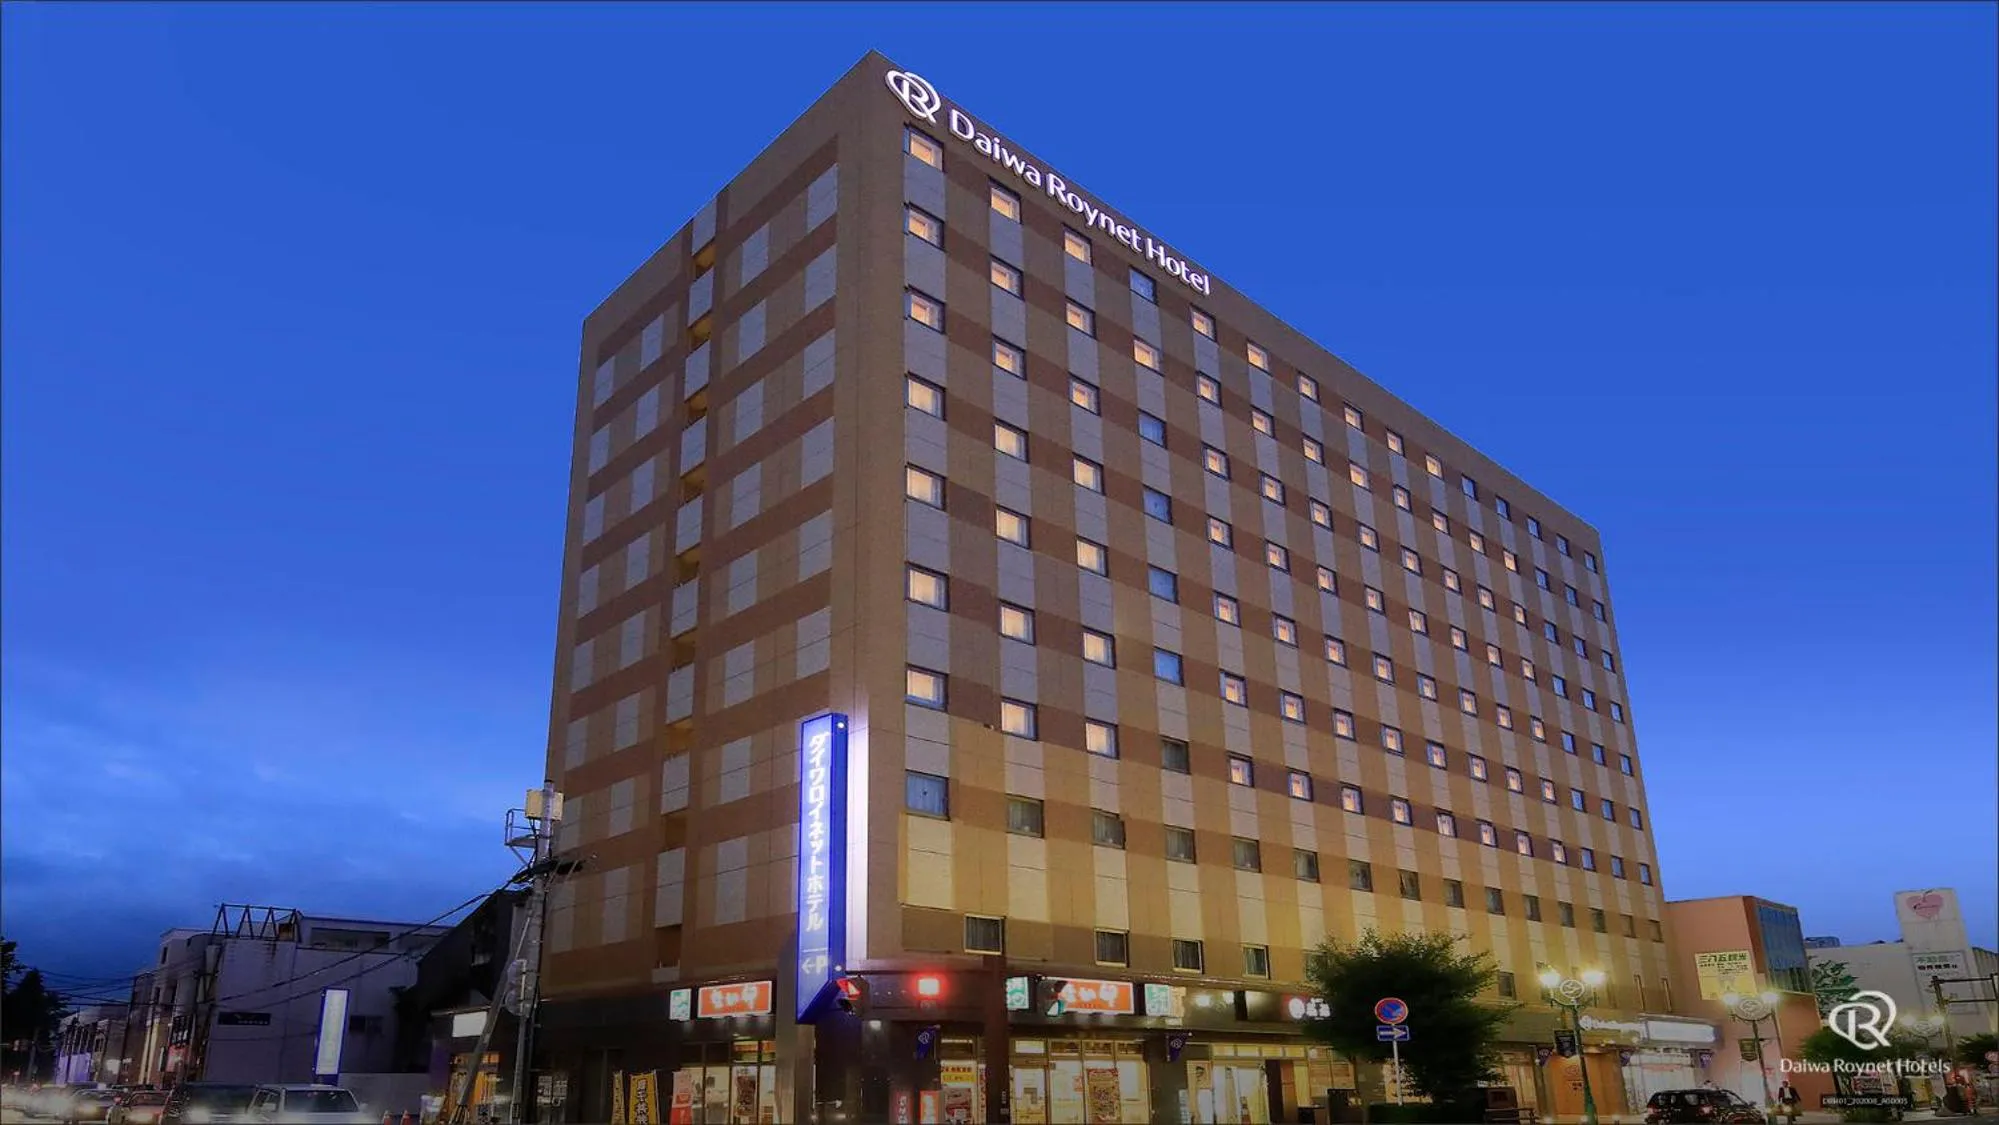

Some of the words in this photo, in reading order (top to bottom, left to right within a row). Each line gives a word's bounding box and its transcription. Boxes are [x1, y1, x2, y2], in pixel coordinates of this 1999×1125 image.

[950, 108, 1042, 187] Daiwa
[1047, 172, 1142, 253] Roynet
[1147, 238, 1211, 295] Hotel
[805, 732, 831, 932] ダイワロイネットホテル
